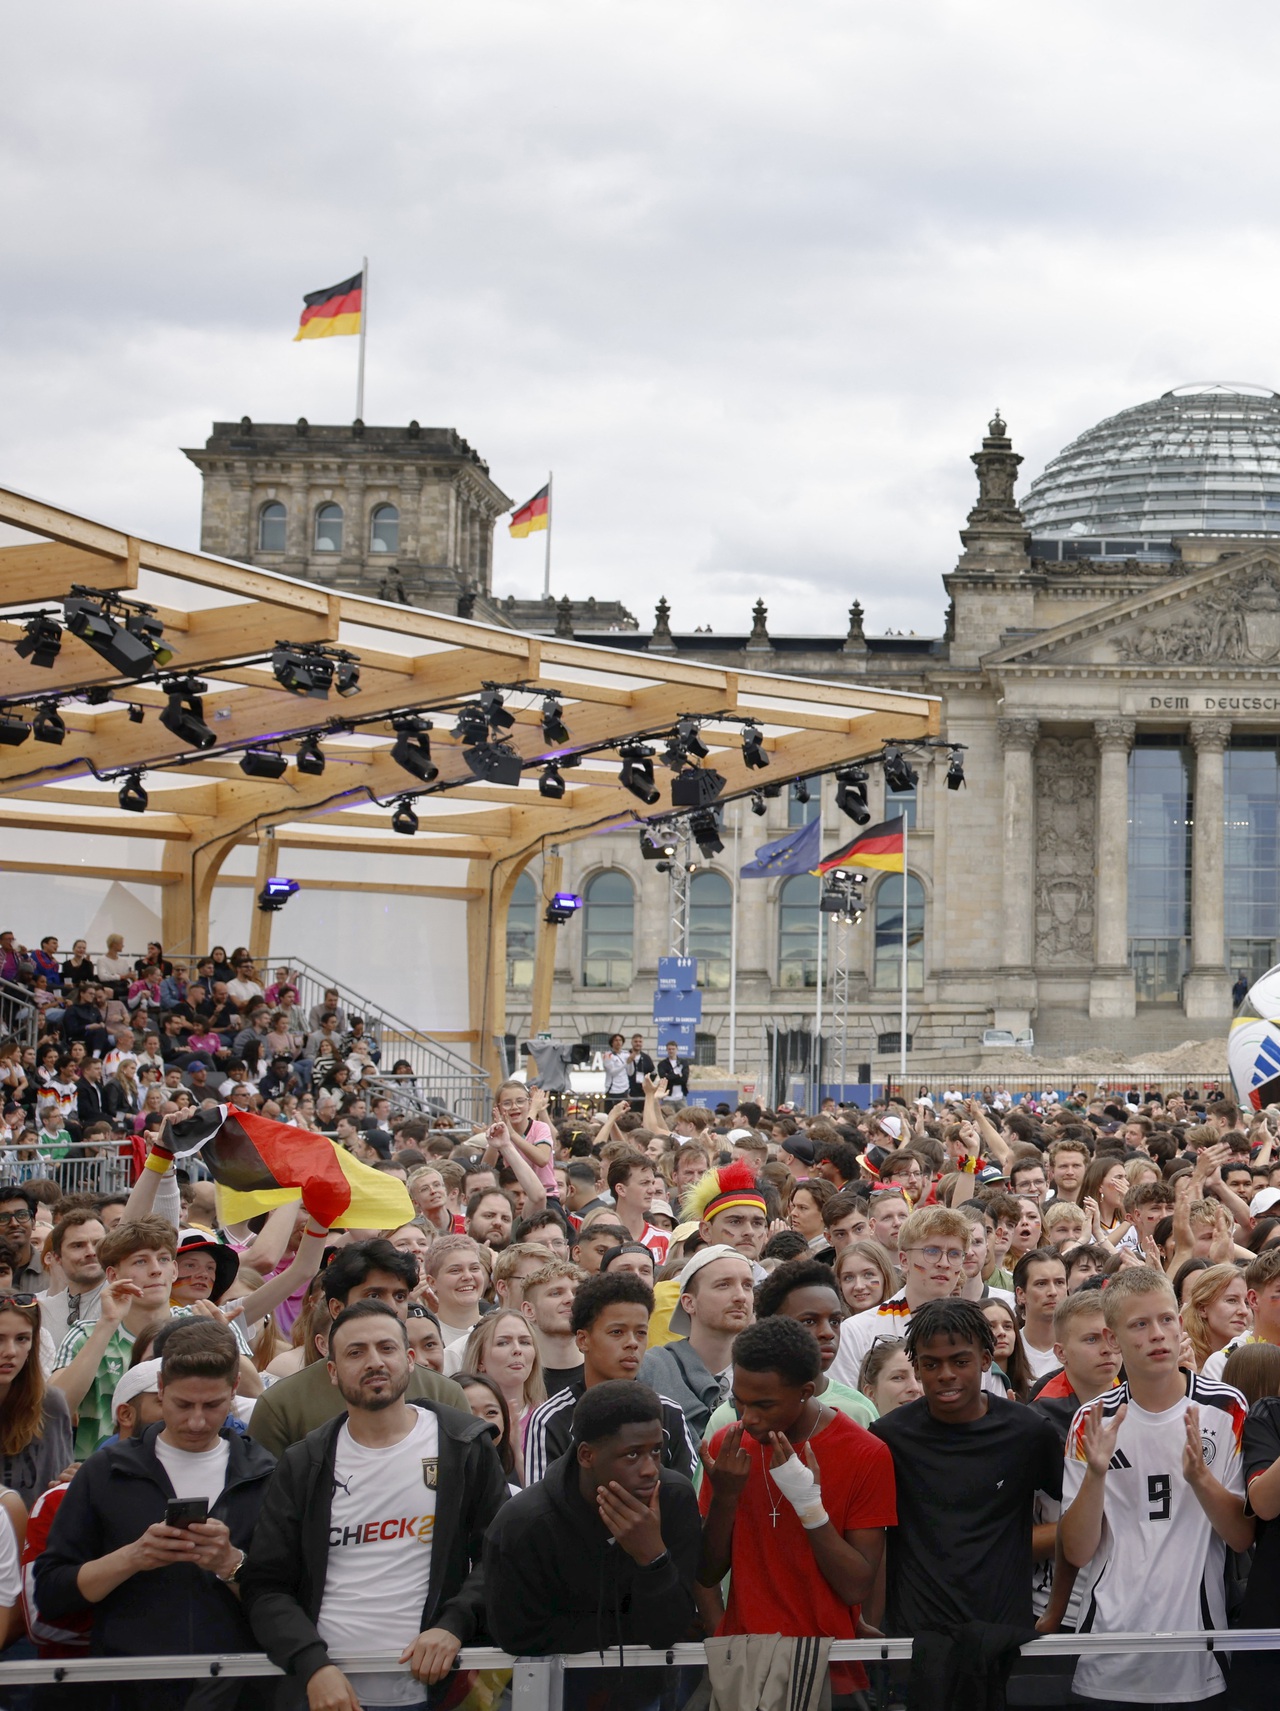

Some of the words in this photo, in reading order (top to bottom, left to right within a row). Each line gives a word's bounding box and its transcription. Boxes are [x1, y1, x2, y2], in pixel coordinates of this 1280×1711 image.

[1150, 696, 1189, 709] DEM
[1147, 1474, 1172, 1522] 9
[328, 1514, 437, 1547] CHECK2
